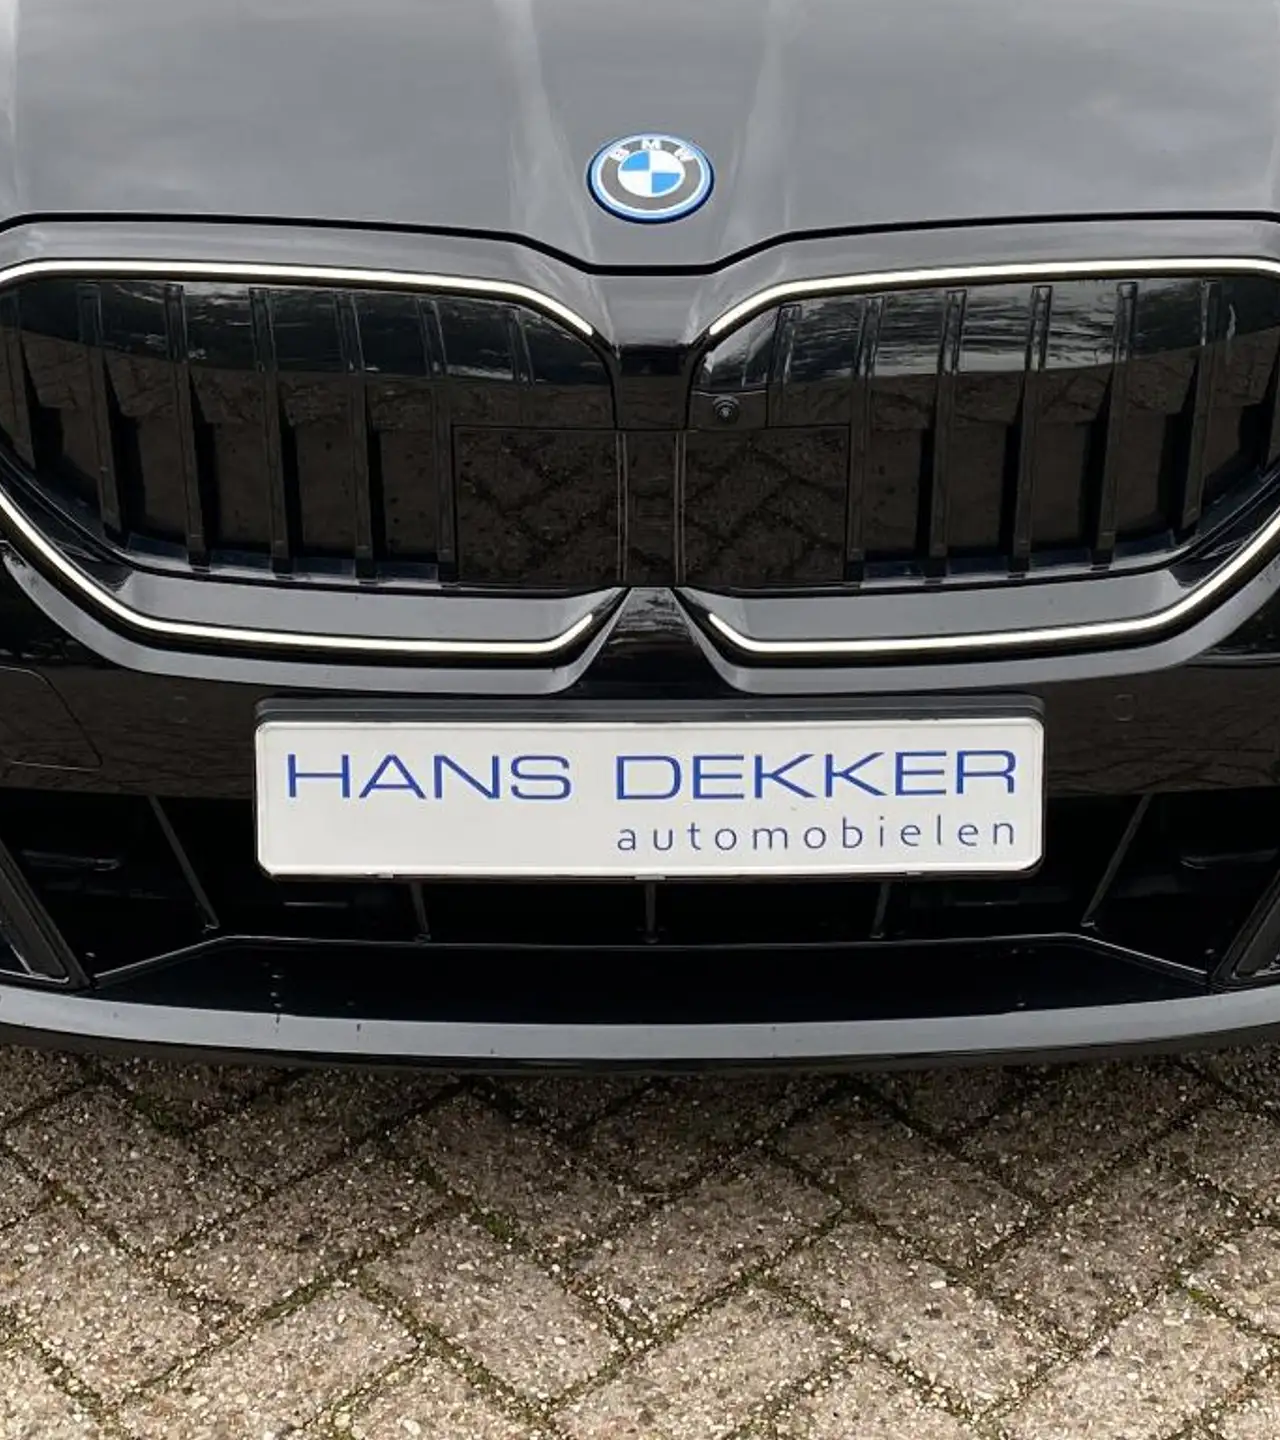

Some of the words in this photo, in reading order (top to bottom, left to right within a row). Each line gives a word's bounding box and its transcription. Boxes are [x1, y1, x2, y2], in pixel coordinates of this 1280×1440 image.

[605, 138, 696, 162] BMW
[286, 753, 572, 801] HANS
[615, 749, 1018, 801] DEKKER
[616, 813, 1016, 851] automobielen
